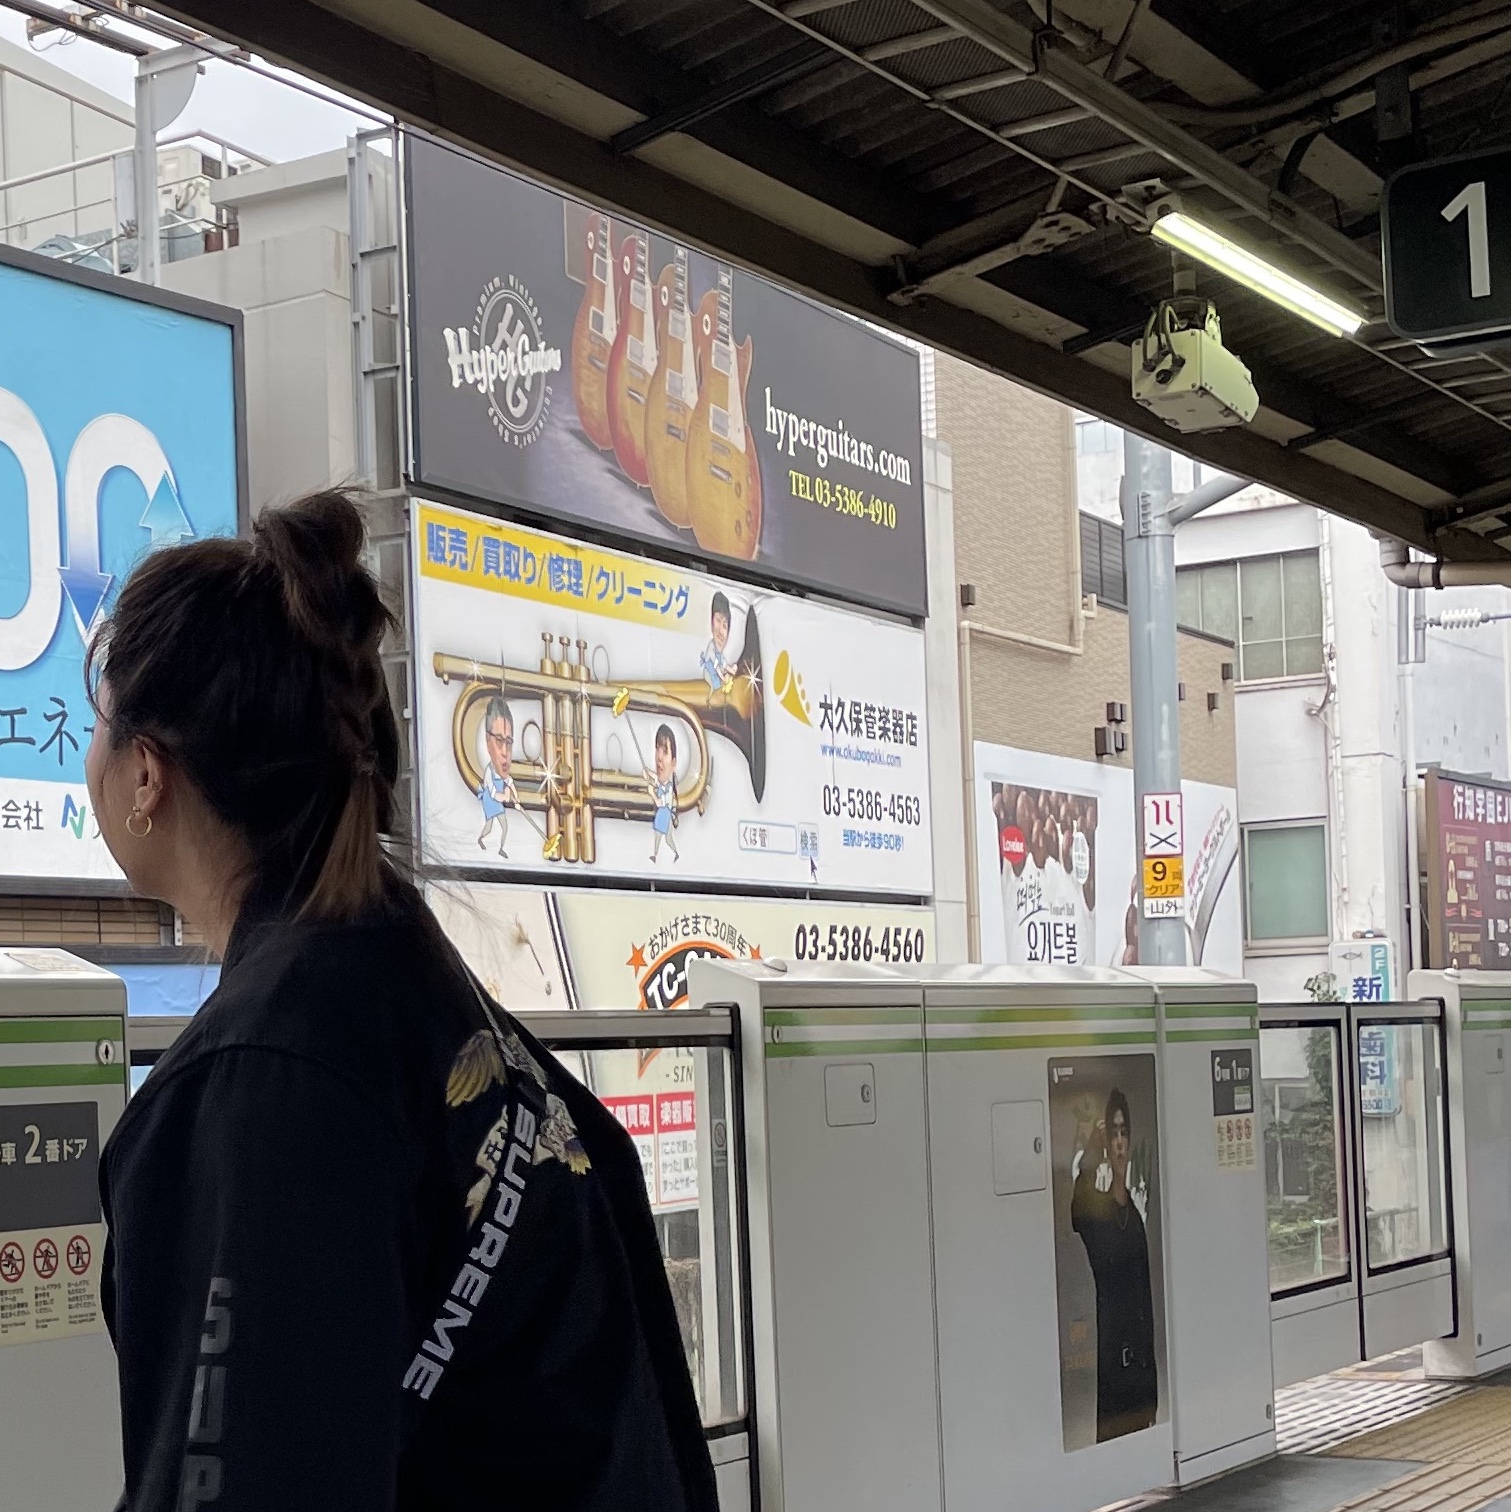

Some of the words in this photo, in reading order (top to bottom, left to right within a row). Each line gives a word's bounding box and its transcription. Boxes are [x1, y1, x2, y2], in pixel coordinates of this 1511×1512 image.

[1440, 181, 1491, 298] 1
[765, 386, 912, 486] hyperguitars.com
[789, 469, 814, 502] TEL
[815, 477, 897, 530] 03-5386-4910
[819, 694, 918, 747] 大久保管楽器店
[823, 784, 921, 825] 03-5386-4563
[1453, 784, 1511, 824] 行知学園EJ
[648, 913, 748, 960] おかげさまで30周年
[795, 923, 925, 963] 03-5386-4560
[1027, 921, 1077, 964] 요거트볼
[401, 1102, 537, 1401] SUPREME
